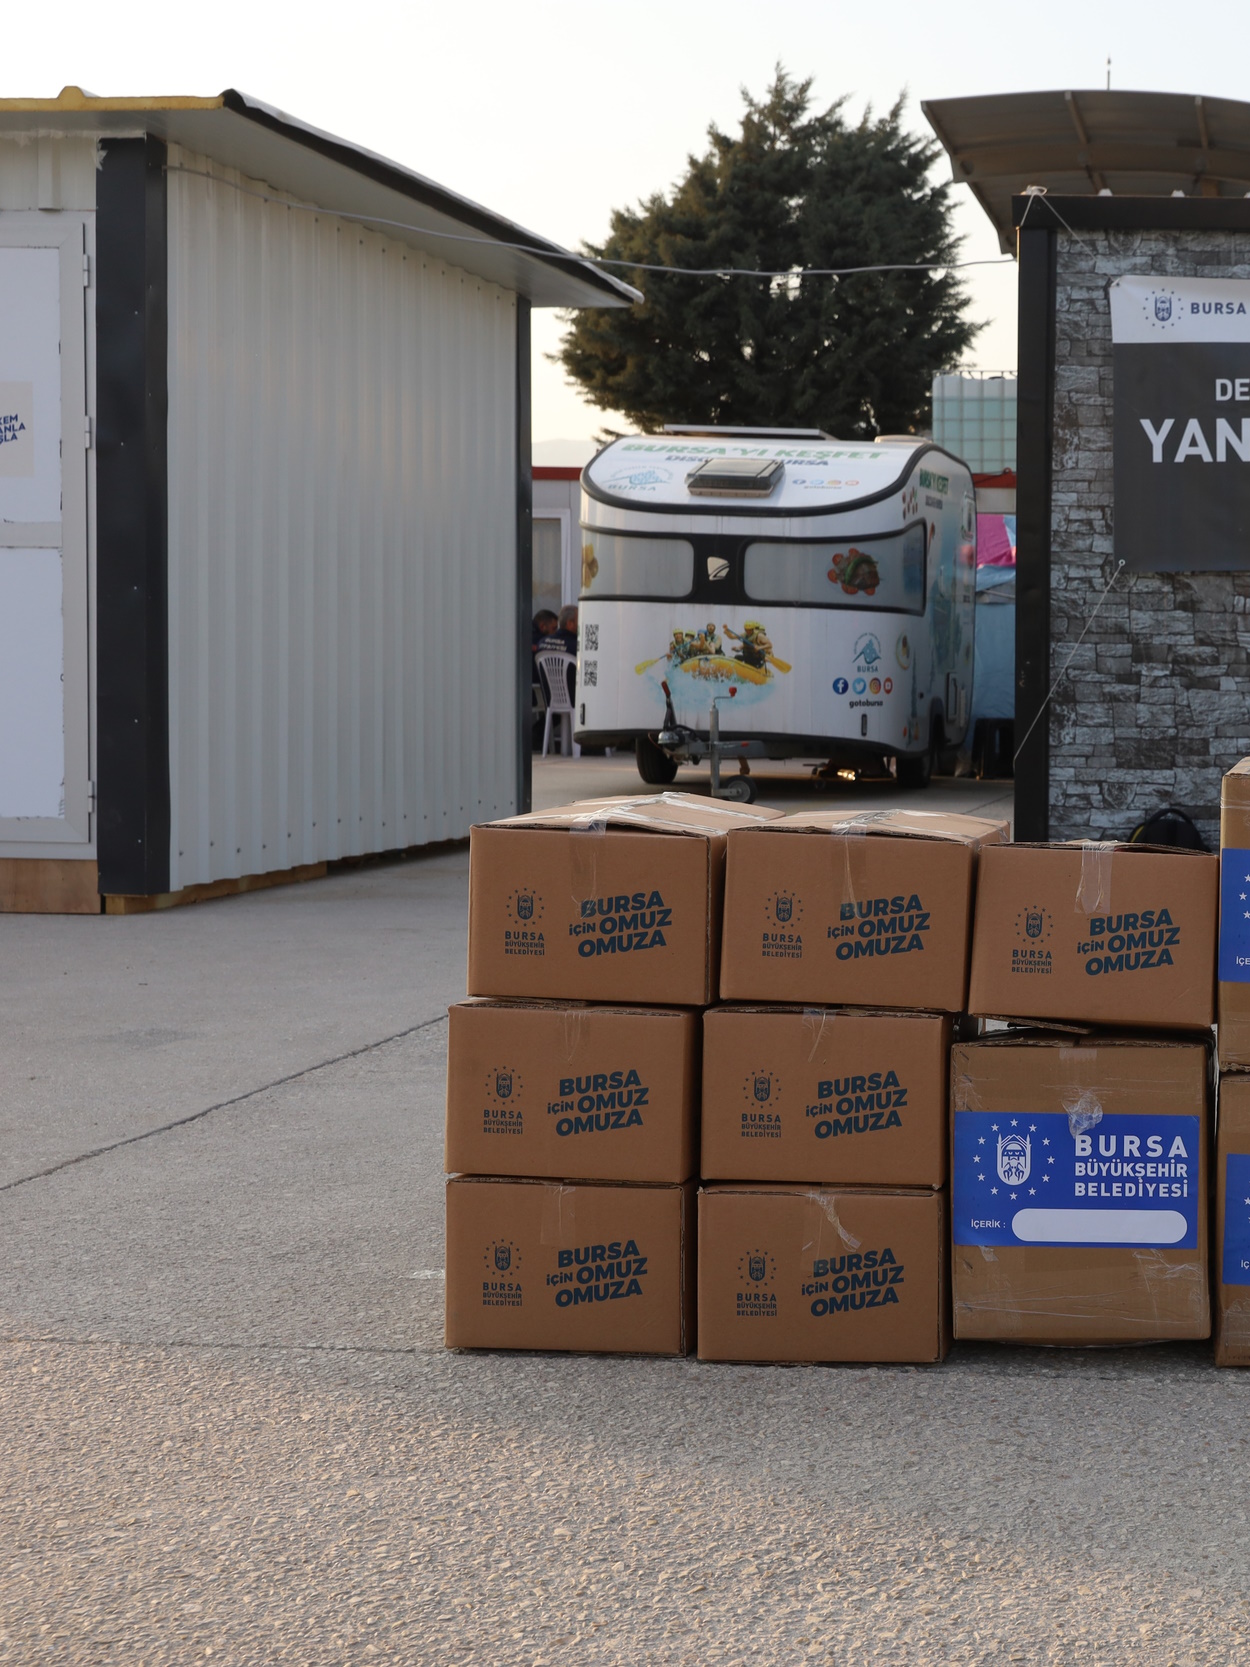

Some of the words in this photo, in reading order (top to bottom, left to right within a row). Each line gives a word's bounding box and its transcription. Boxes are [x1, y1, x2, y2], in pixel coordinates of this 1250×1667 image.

[1190, 302, 1247, 315] BURSA
[857, 665, 879, 673] BURSA
[581, 891, 664, 918] BURSA
[840, 894, 923, 921] BURSA
[599, 909, 672, 935] OMUZ
[858, 912, 930, 938] OMUZ
[1090, 908, 1173, 936] BURSA
[505, 931, 544, 941] BURSA
[578, 930, 666, 957] OMUZA
[762, 943, 802, 951] BÜYÜKŞEHİR
[763, 933, 802, 943] BURSA
[836, 934, 924, 960] OMUZA
[1108, 927, 1180, 953] OMUZ
[762, 950, 802, 958] BELEDİYESİ
[1013, 949, 1052, 959] BURSA
[1085, 948, 1173, 976] OMUZA
[1012, 966, 1051, 974] BELEDİYESİ
[560, 1070, 641, 1096] BURSA
[818, 1071, 900, 1099] BURSA
[578, 1088, 649, 1113] OMUZ
[836, 1089, 907, 1115] OMUZ
[484, 1110, 522, 1119] BURSA
[484, 1119, 522, 1127] BÜYÜKŞEHİR
[556, 1109, 643, 1136] OMUZA
[742, 1114, 781, 1123] BURSA
[815, 1110, 902, 1139] OMUZA
[741, 1130, 781, 1138] BELEDİYESİ
[1075, 1135, 1188, 1158] BURSA
[1075, 1159, 1187, 1179] BÜYÜKŞEHİR
[1075, 1179, 1187, 1197] BELEDİYESİ
[971, 1219, 1000, 1229] İÇERİK
[558, 1240, 640, 1268] BURSA
[814, 1248, 896, 1277] BURSA
[576, 1258, 647, 1284] OMUZ
[832, 1266, 904, 1293] OMUZ
[483, 1283, 522, 1291] BURSA
[483, 1291, 522, 1299] BÜYÜKŞEHİR
[555, 1279, 642, 1307] OMUZA
[737, 1293, 776, 1301] BURSA
[483, 1298, 522, 1306] BELEDİYESİ
[737, 1301, 777, 1309] BÜYÜKŞEHİR
[737, 1308, 777, 1316] BELEDİYESİ
[811, 1287, 899, 1317] OMUZA
